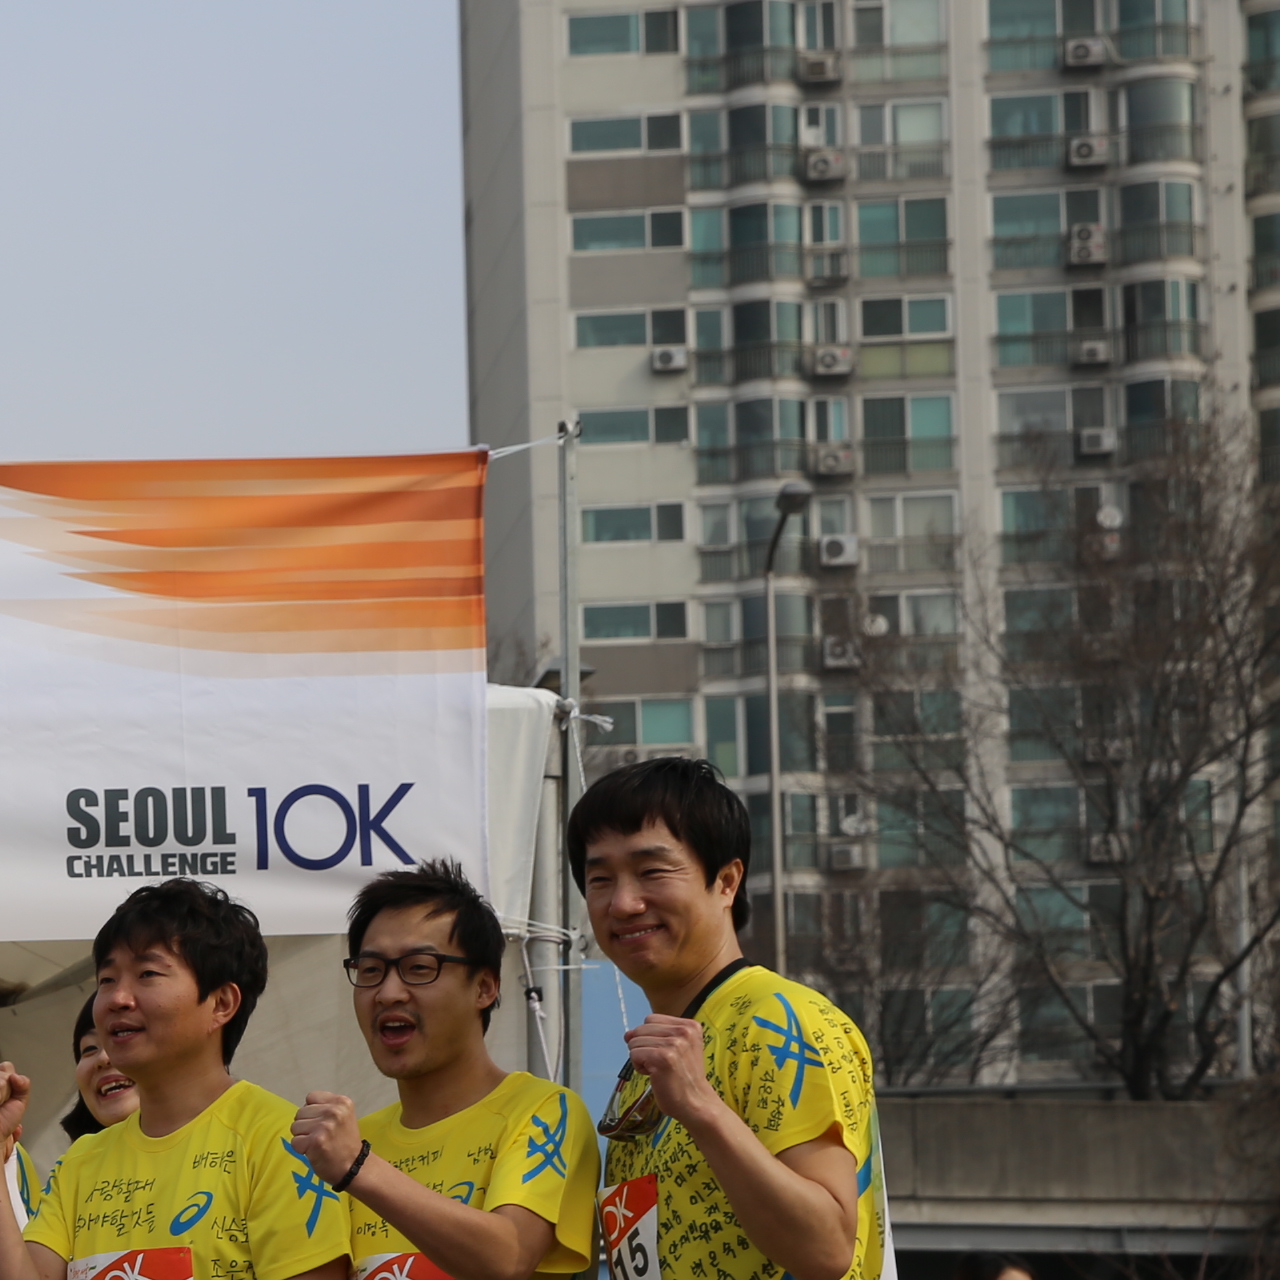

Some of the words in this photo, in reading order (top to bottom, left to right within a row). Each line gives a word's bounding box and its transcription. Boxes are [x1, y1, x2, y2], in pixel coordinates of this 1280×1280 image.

[66, 786, 236, 849] SEOUL
[247, 782, 416, 871] 10K
[66, 852, 236, 878] CHALLENGE
